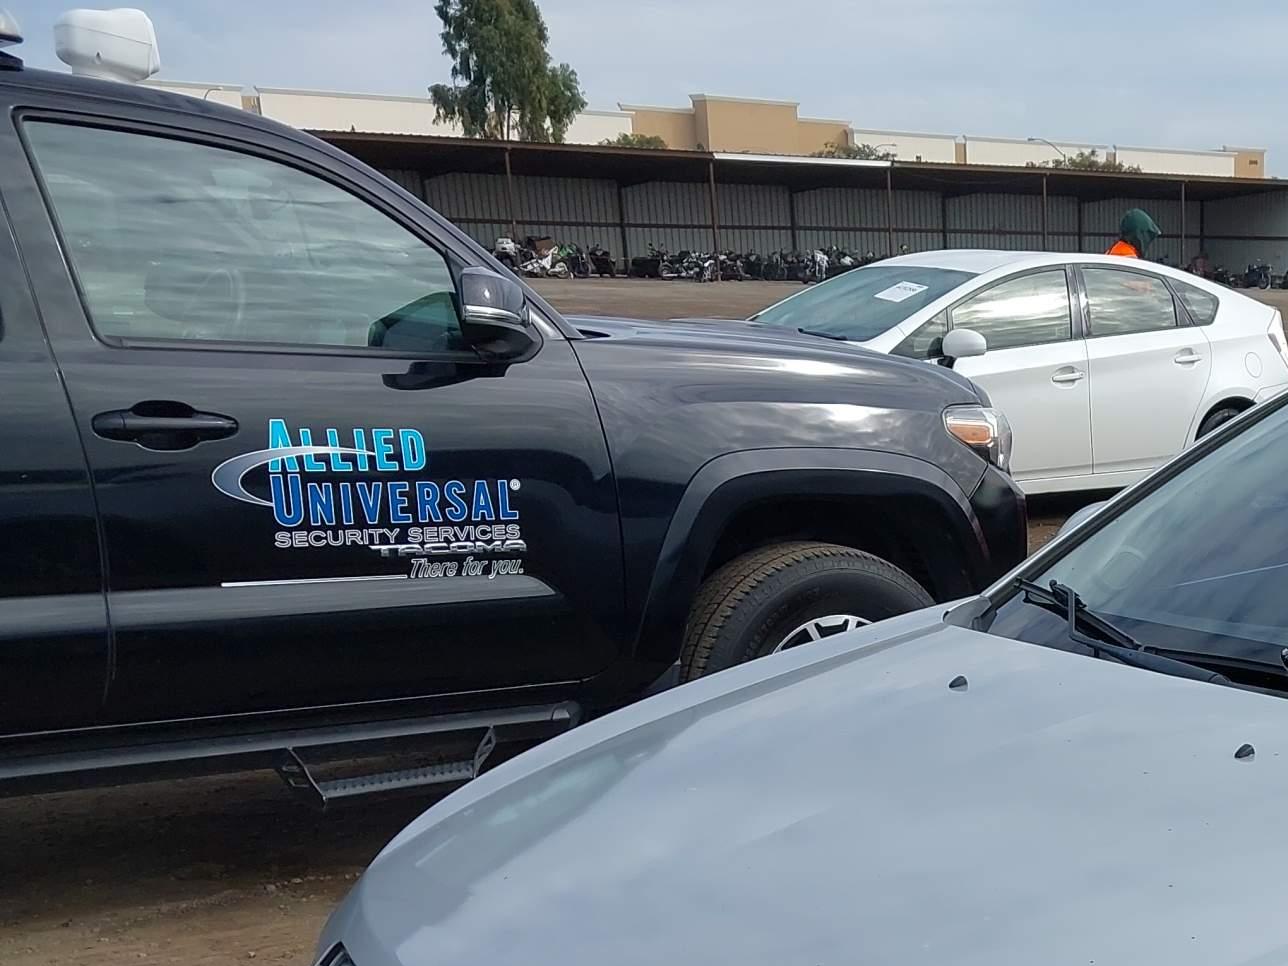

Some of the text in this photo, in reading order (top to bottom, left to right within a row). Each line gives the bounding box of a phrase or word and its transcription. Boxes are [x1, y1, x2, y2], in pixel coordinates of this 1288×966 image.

[268, 418, 426, 473] ALLIED
[274, 524, 521, 548] SECURITY SERVICES
[368, 539, 527, 558] TACOMA
[410, 556, 525, 580] There for you.
